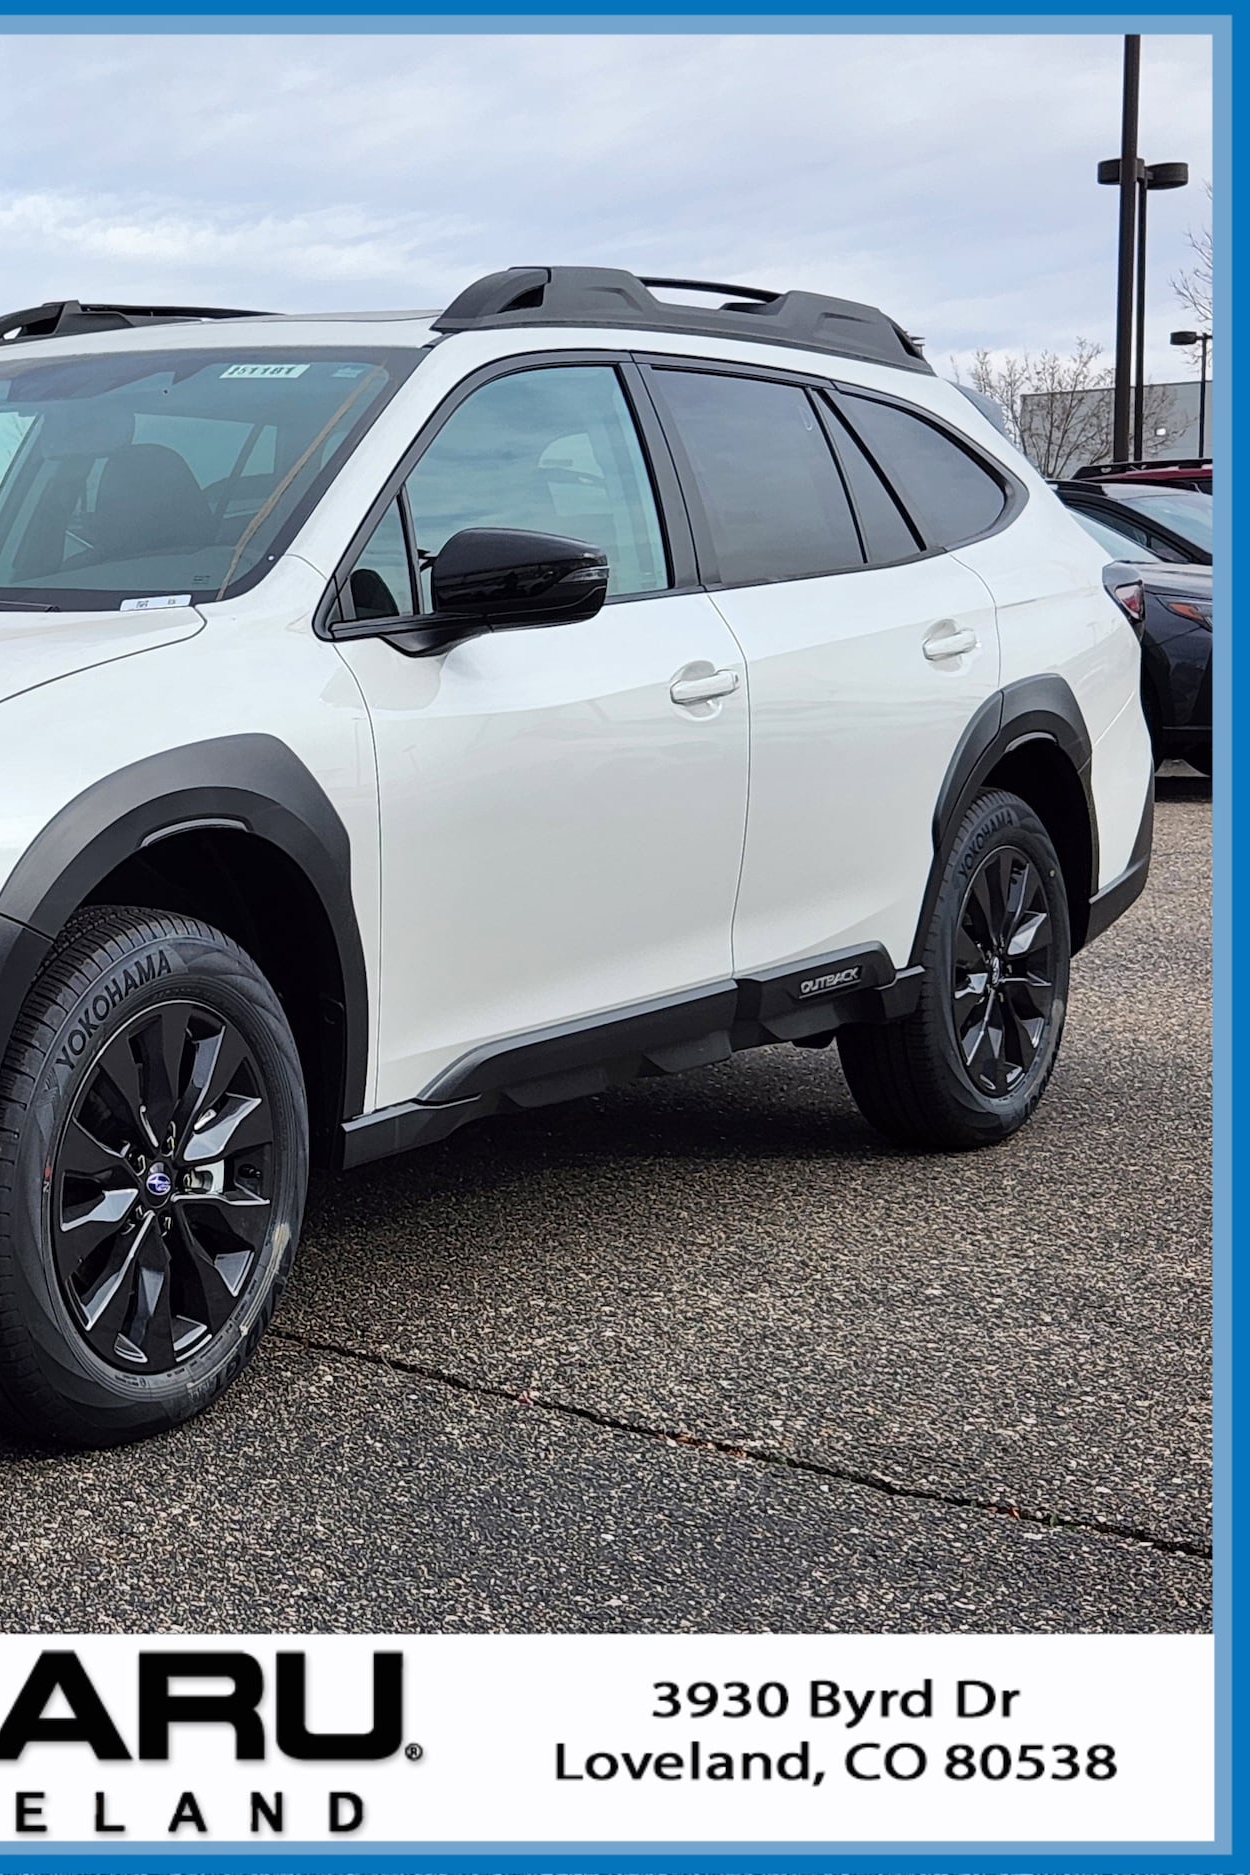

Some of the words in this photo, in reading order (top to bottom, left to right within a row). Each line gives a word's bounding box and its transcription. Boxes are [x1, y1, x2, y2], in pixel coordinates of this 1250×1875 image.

[957, 808, 1014, 879] YOKOHAMA
[55, 949, 172, 1071] YOKOHAMA
[800, 966, 860, 994] OUTBACK
